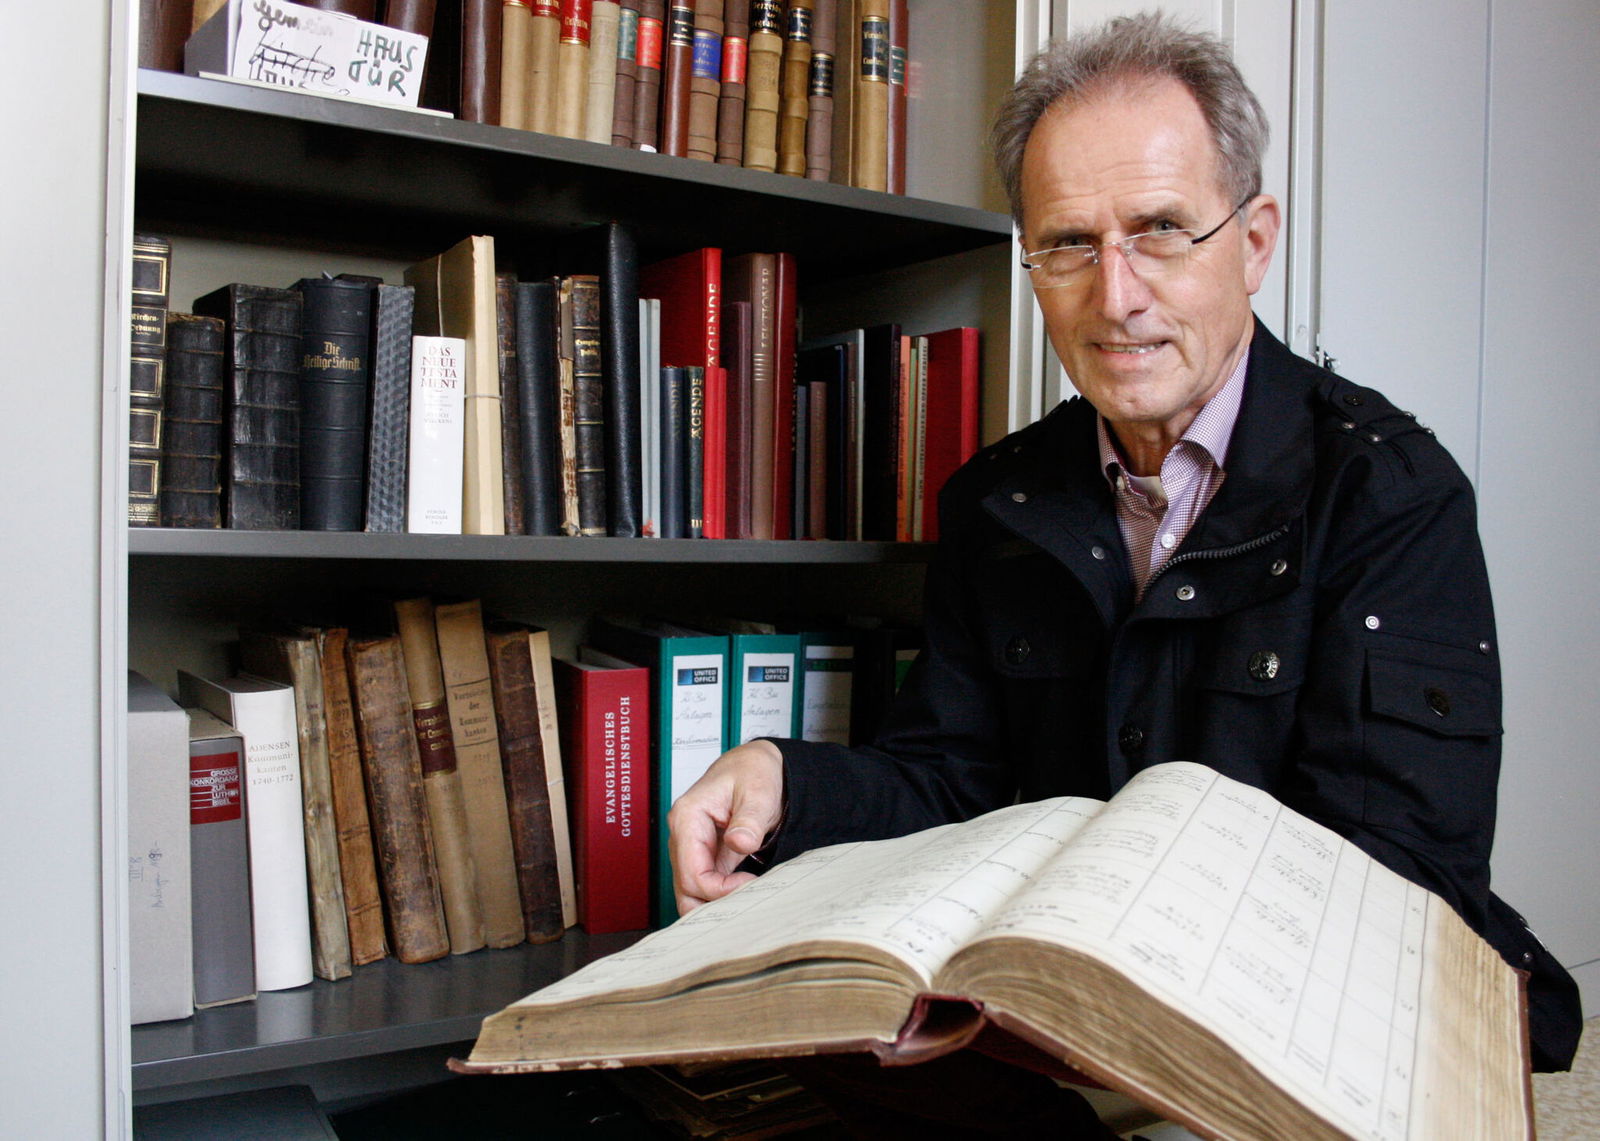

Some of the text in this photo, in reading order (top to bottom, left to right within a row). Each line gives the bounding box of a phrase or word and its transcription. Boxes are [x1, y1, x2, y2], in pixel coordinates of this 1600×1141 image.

[356, 28, 418, 73] HAUS
[706, 282, 720, 367] AGENDE
[323, 341, 341, 356] Die
[428, 346, 451, 356] DAS
[422, 356, 457, 368] NEUE
[420, 367, 458, 378] TESTA
[420, 378, 458, 389] MENT
[691, 377, 702, 440] AGENDE
[694, 669, 717, 677] UNITED
[249, 741, 290, 752] ADENSEN
[210, 767, 238, 777] GROSSE
[604, 711, 616, 824] EVANGELISCHES
[621, 696, 632, 837] GOTTESDIENSTBUCH
[190, 774, 239, 787] KONKORDANZ
[212, 783, 226, 791] ZUR
